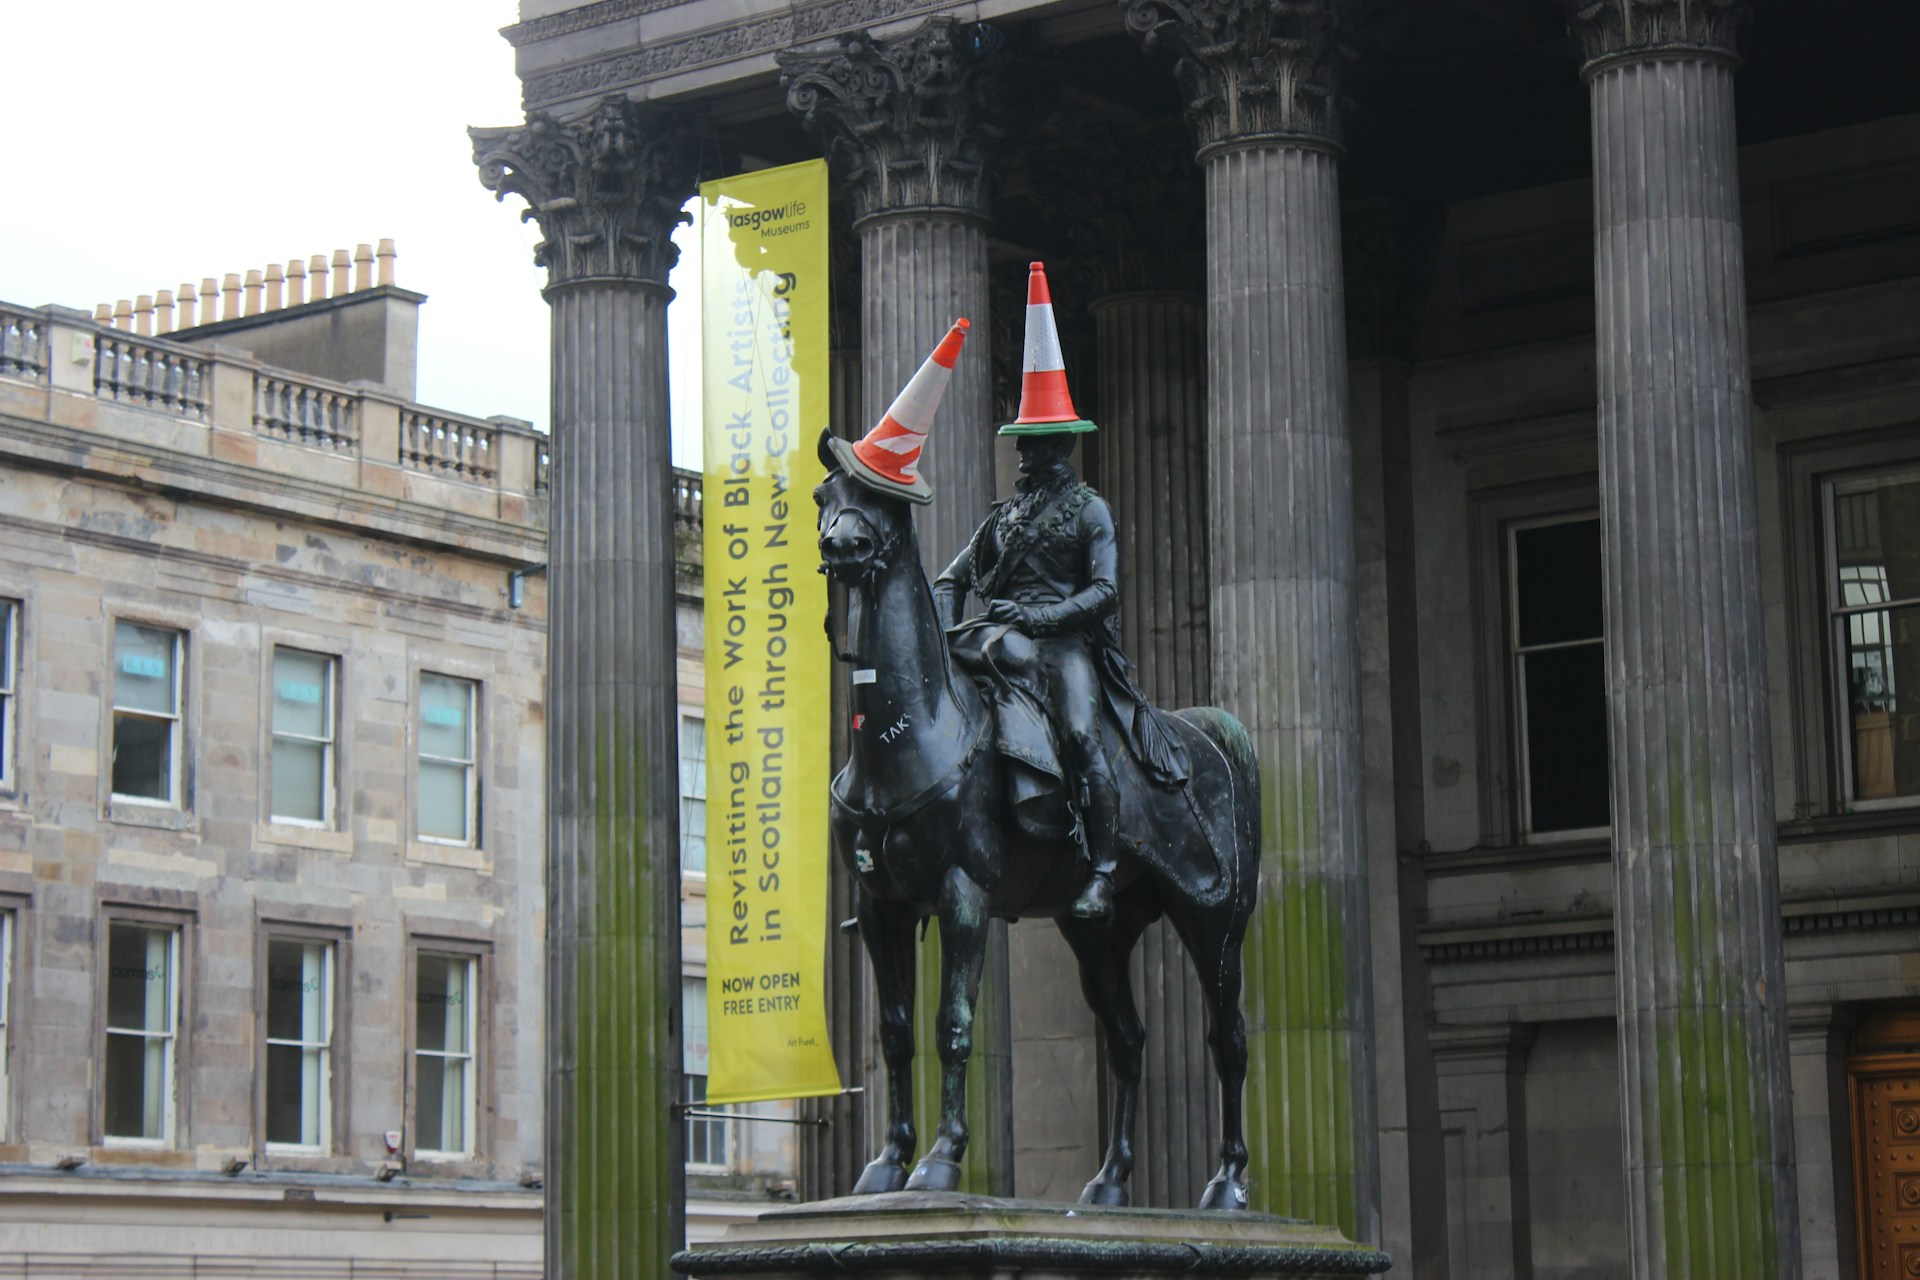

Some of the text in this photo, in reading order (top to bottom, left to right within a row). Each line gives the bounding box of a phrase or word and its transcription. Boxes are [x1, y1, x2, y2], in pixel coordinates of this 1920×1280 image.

[761, 220, 810, 238] Museums
[722, 278, 755, 945] Revisiting the Work of Black Artists
[756, 272, 797, 942] in Scotland through New Collecting
[722, 972, 800, 994] NOW OPEN
[724, 995, 800, 1016] FREE ENTRY
[787, 1039, 797, 1047] Art
